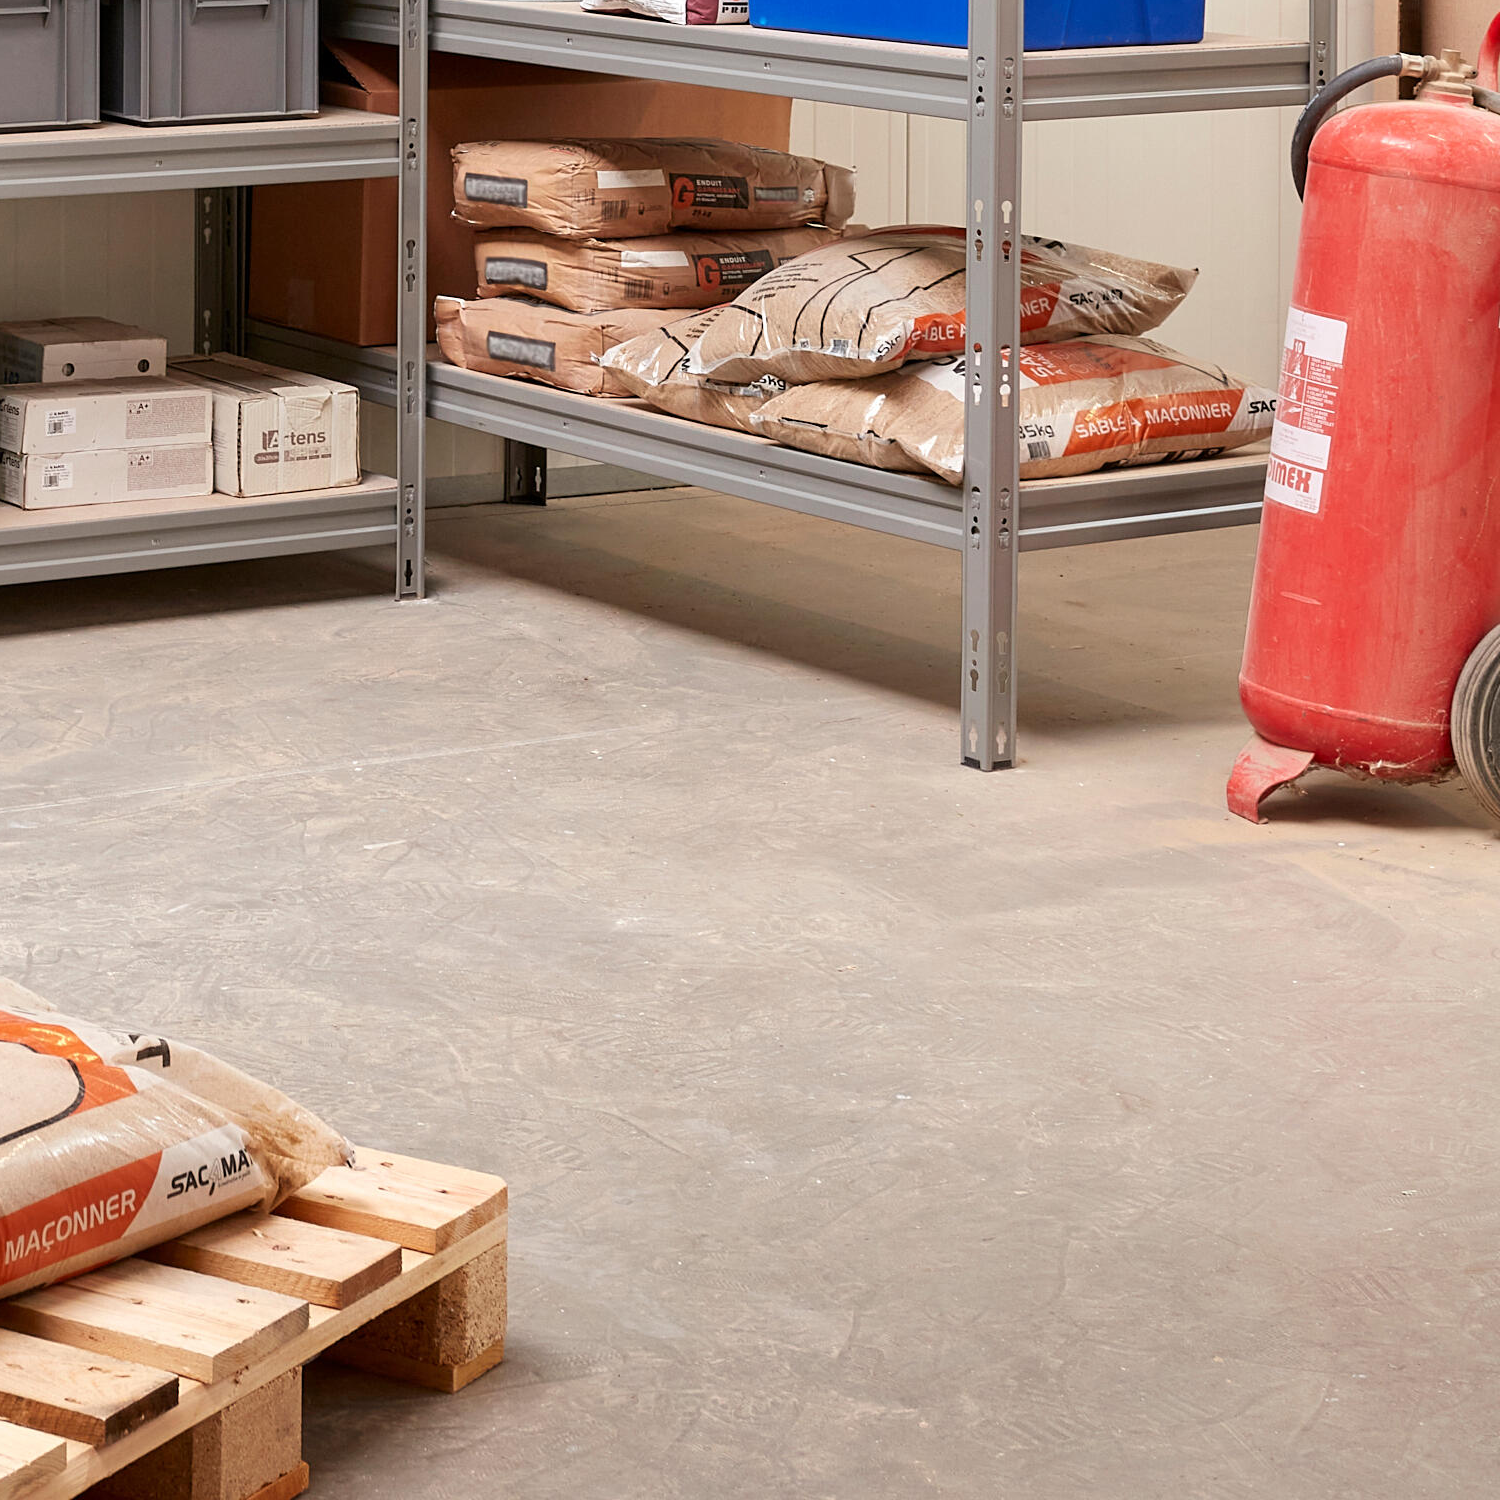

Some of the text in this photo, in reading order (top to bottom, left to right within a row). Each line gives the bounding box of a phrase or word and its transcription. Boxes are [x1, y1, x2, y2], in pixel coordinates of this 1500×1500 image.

[695, 179, 723, 187] ENDUIT
[719, 256, 747, 264] ENDUIT
[1020, 297, 1052, 318] NER
[1295, 341, 1303, 354] 10
[1075, 416, 1127, 439] SABLE
[1144, 402, 1233, 426] MAÇONNER
[4, 1188, 137, 1266] MAÇONNER
